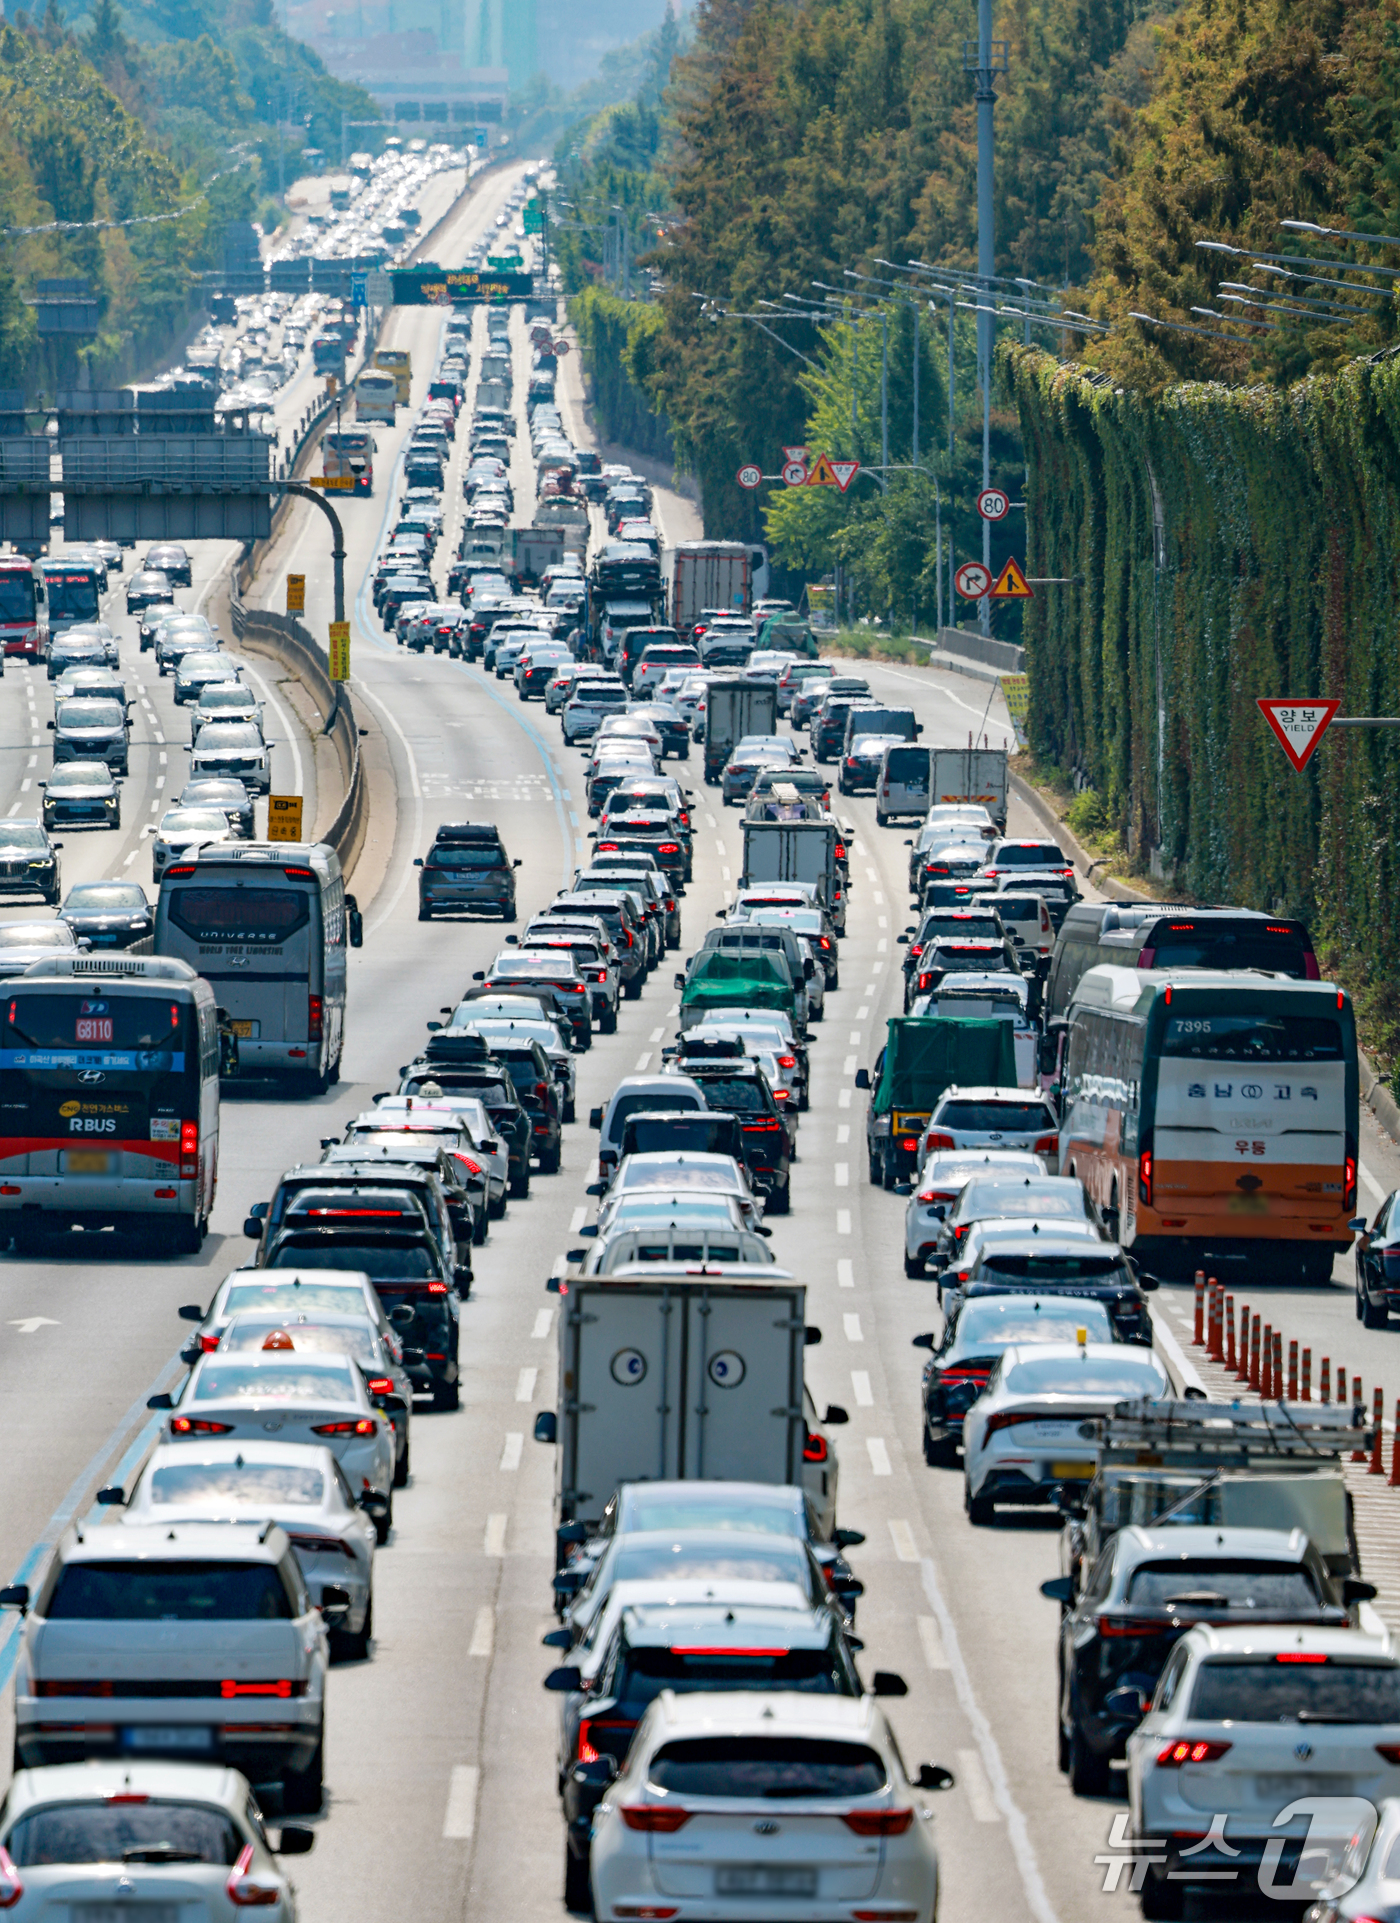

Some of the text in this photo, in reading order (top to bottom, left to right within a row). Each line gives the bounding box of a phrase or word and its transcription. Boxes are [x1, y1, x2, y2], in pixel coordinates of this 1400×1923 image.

[742, 470, 758, 483] 80
[984, 497, 1004, 514] 80
[1280, 709, 1318, 723] 양보
[1282, 724, 1315, 732] YIELD
[200, 932, 277, 940] UNIVERSE
[199, 946, 284, 956] WORLD TOUR LIMOUSINE
[77, 1020, 112, 1039] G8110
[1175, 1021, 1212, 1033] 7395
[1187, 1083, 1319, 1101] 충남 고속
[1234, 1140, 1267, 1156] 우등
